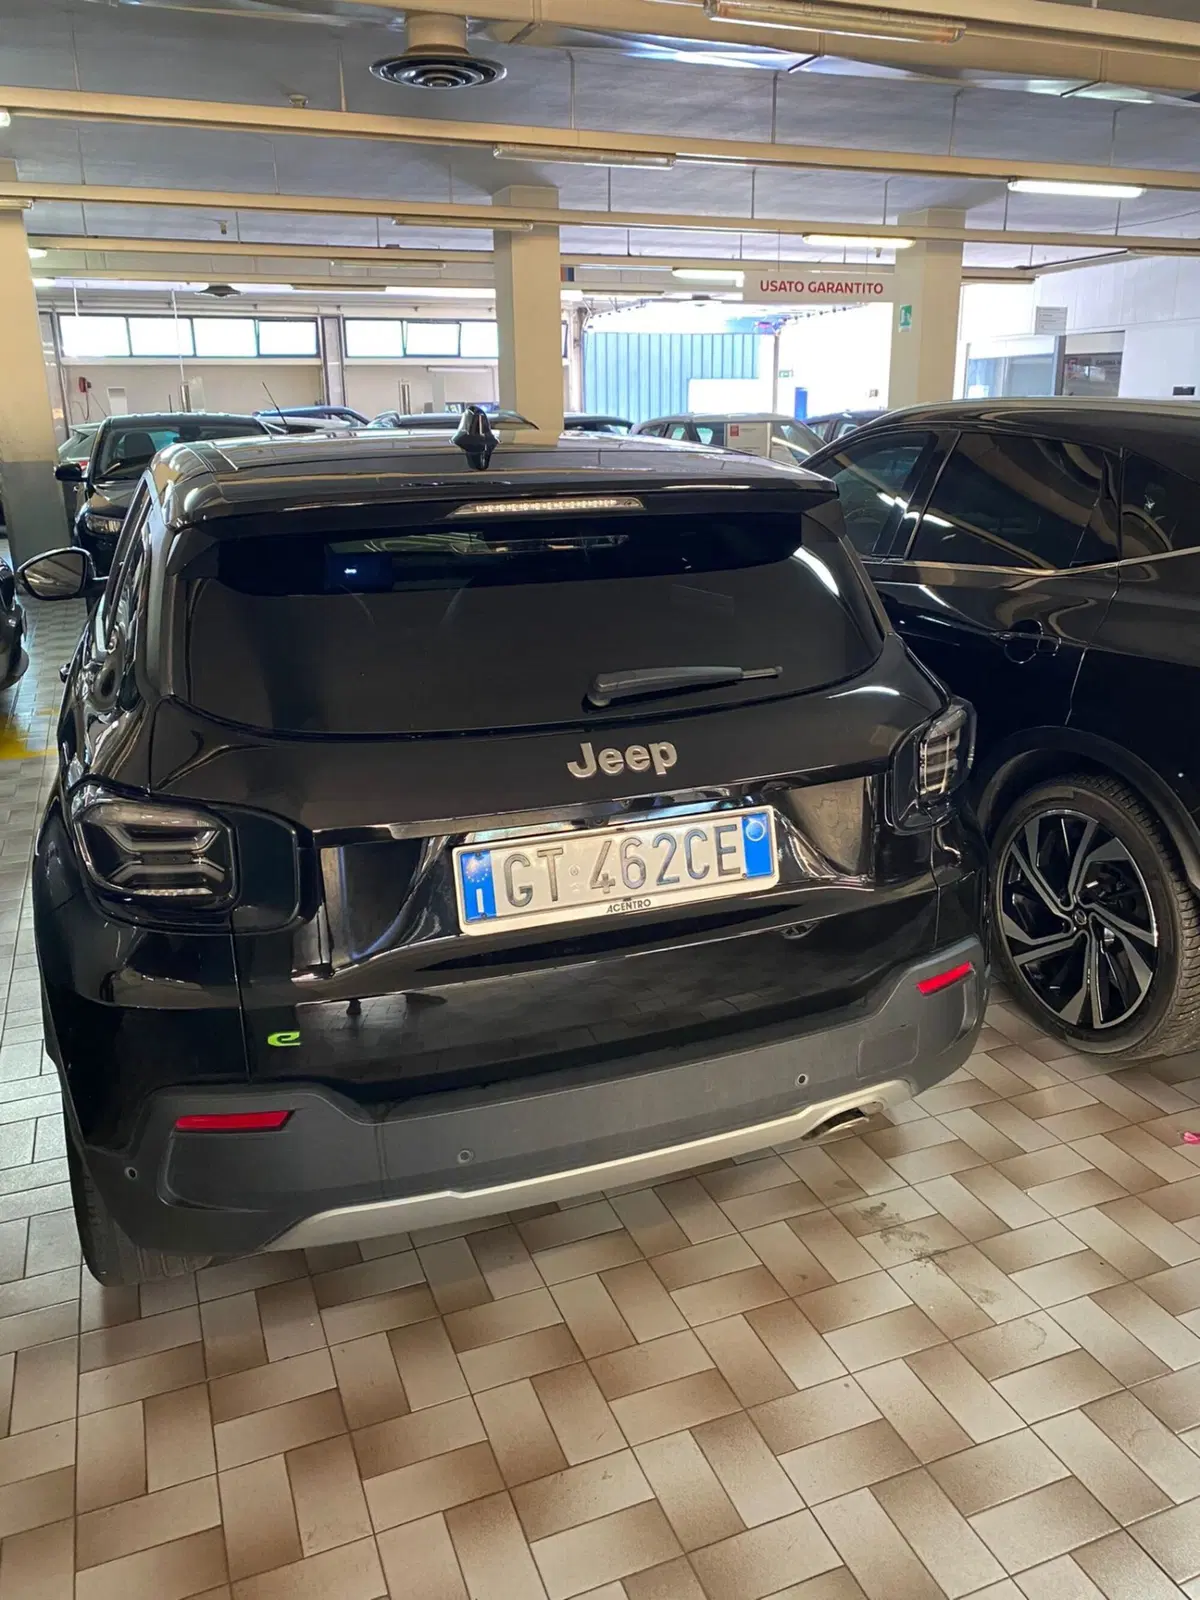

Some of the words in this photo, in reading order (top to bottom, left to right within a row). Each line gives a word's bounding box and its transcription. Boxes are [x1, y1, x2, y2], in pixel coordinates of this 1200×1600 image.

[760, 280, 804, 292] USATO
[808, 281, 883, 294] GARANTITO
[567, 741, 678, 778] Jeep
[503, 847, 564, 907] GT
[606, 898, 652, 913] ACENTRO
